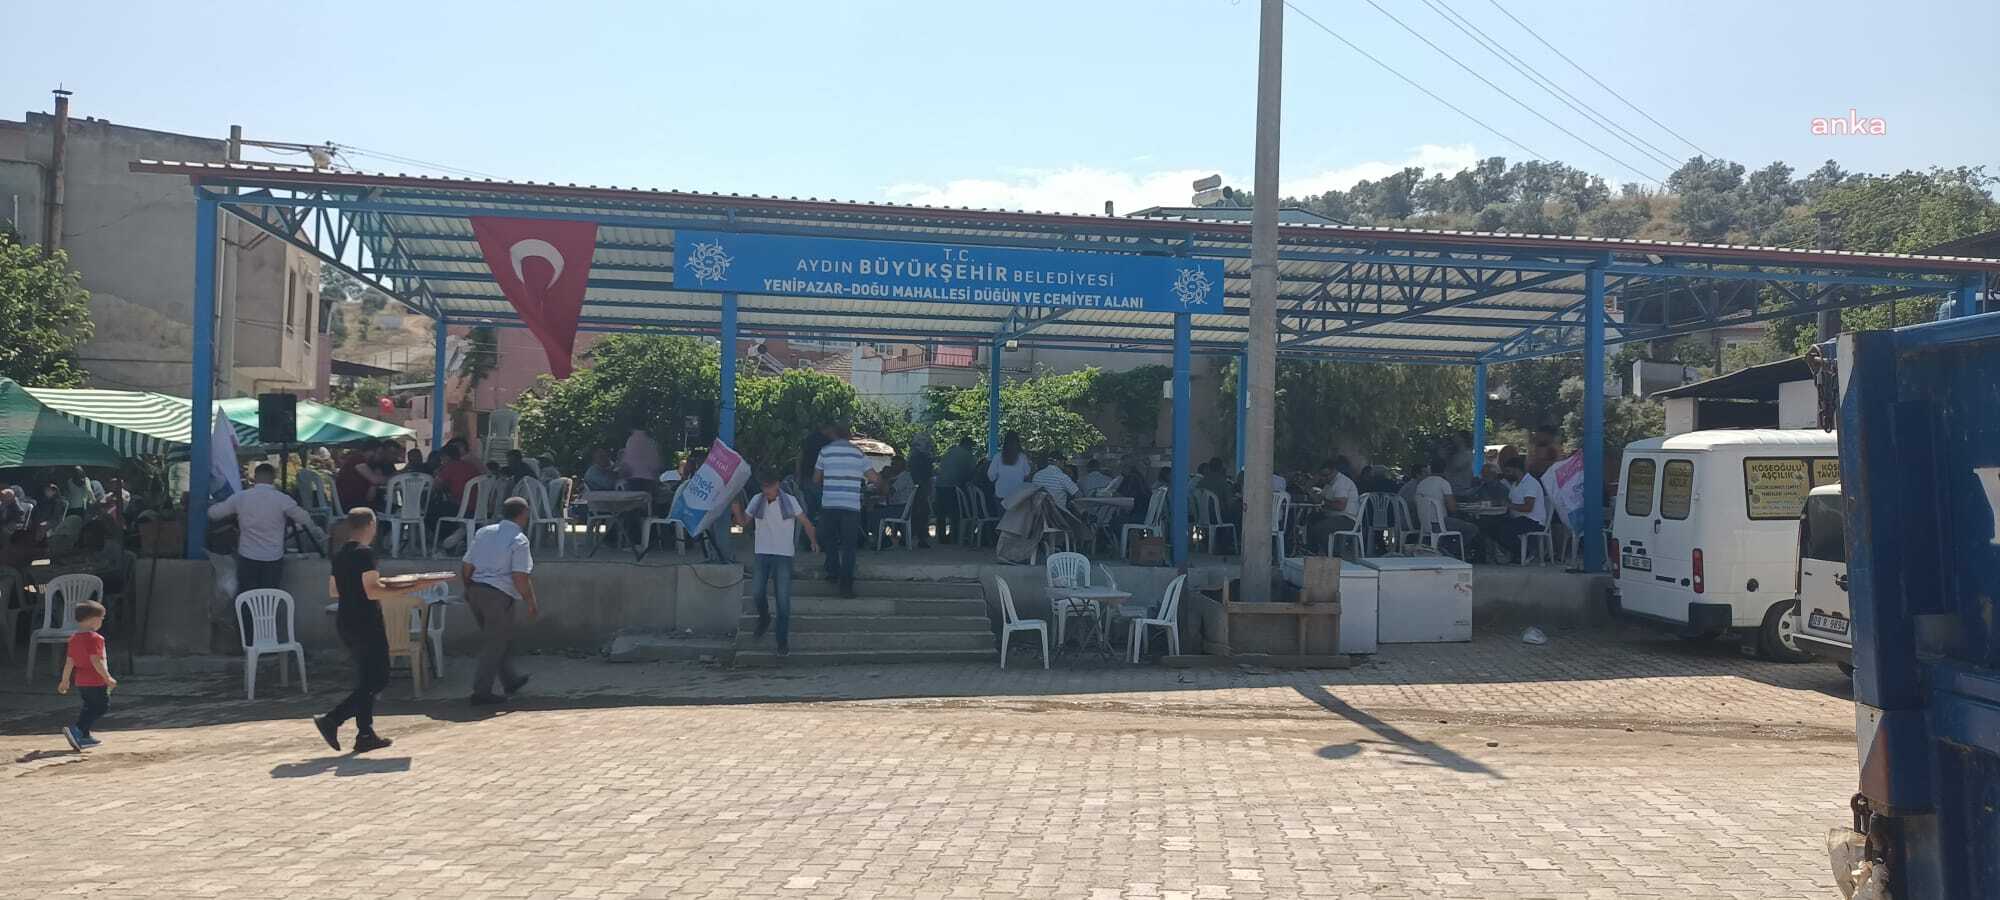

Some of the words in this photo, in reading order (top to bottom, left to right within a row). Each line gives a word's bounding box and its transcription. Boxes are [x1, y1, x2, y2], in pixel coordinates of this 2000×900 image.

[943, 248, 975, 262] T.C.
[796, 258, 852, 273] AYDIN
[859, 257, 1008, 282] BÜYÜKŞEHİR
[1013, 270, 1115, 287] BELEDİYESİ
[892, 285, 971, 300] MAHALLESİ
[974, 287, 1020, 303] DÜĞÜN
[1023, 291, 1040, 304] VE
[1043, 291, 1100, 307] CEMİYET
[1103, 295, 1143, 308] ALANI
